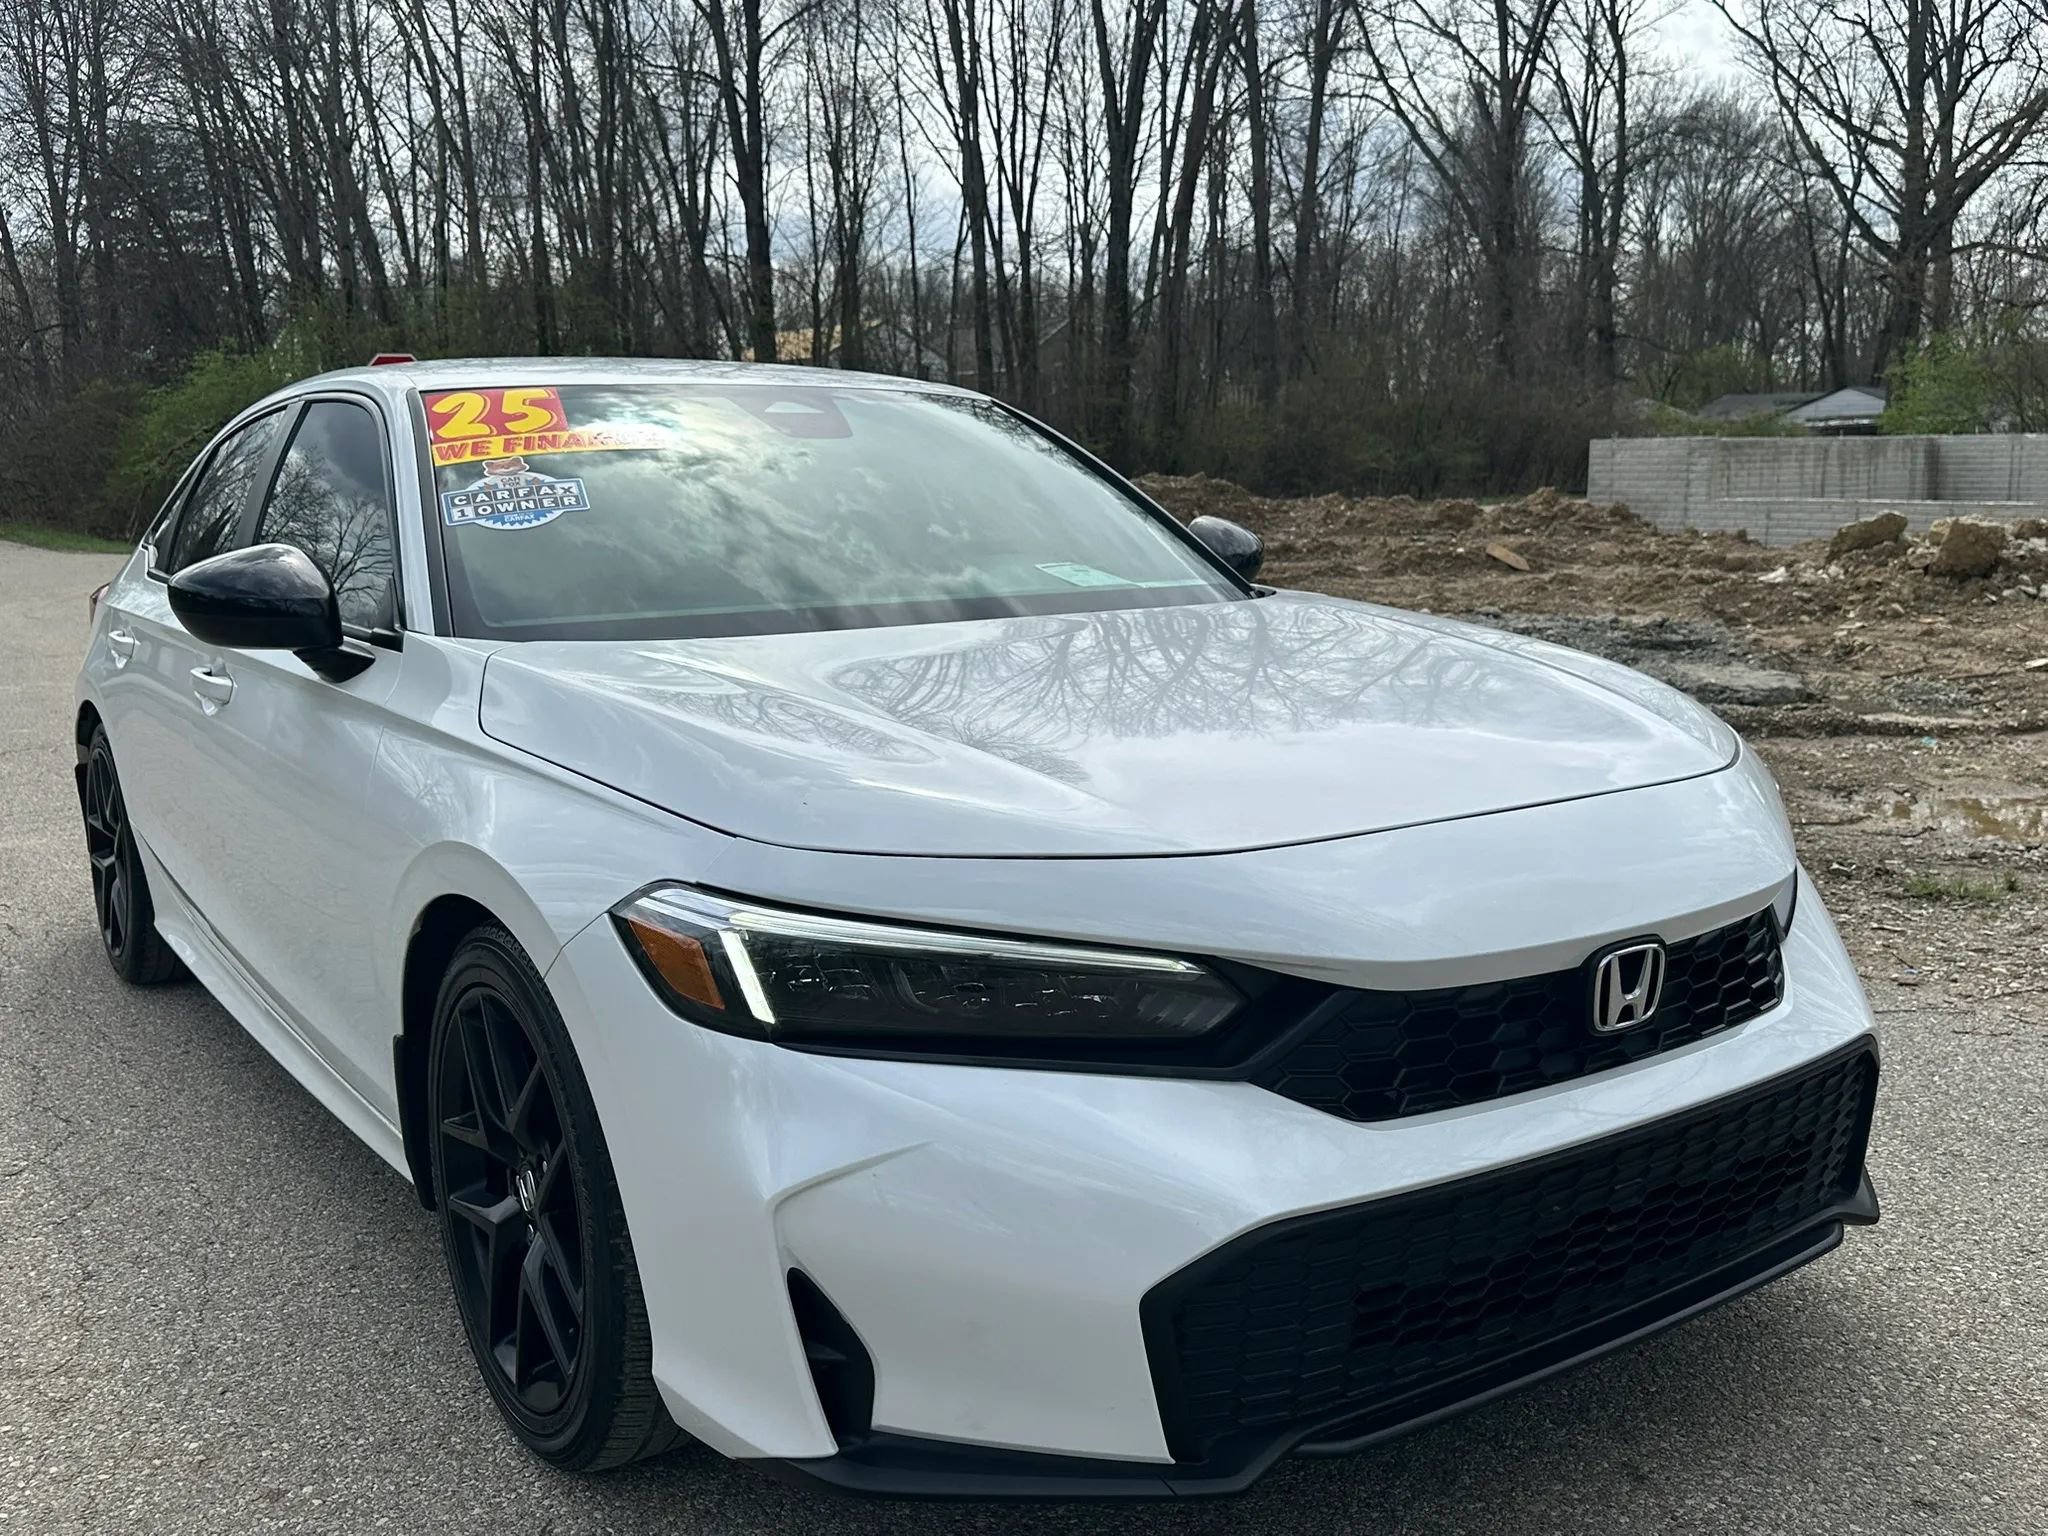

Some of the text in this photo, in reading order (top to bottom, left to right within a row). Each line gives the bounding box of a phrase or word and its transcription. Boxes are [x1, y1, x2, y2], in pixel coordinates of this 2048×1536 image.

[432, 389, 557, 440] 25
[436, 439, 492, 461] WE
[453, 485, 576, 505] CARFAX
[456, 496, 577, 520] 1 OWNER
